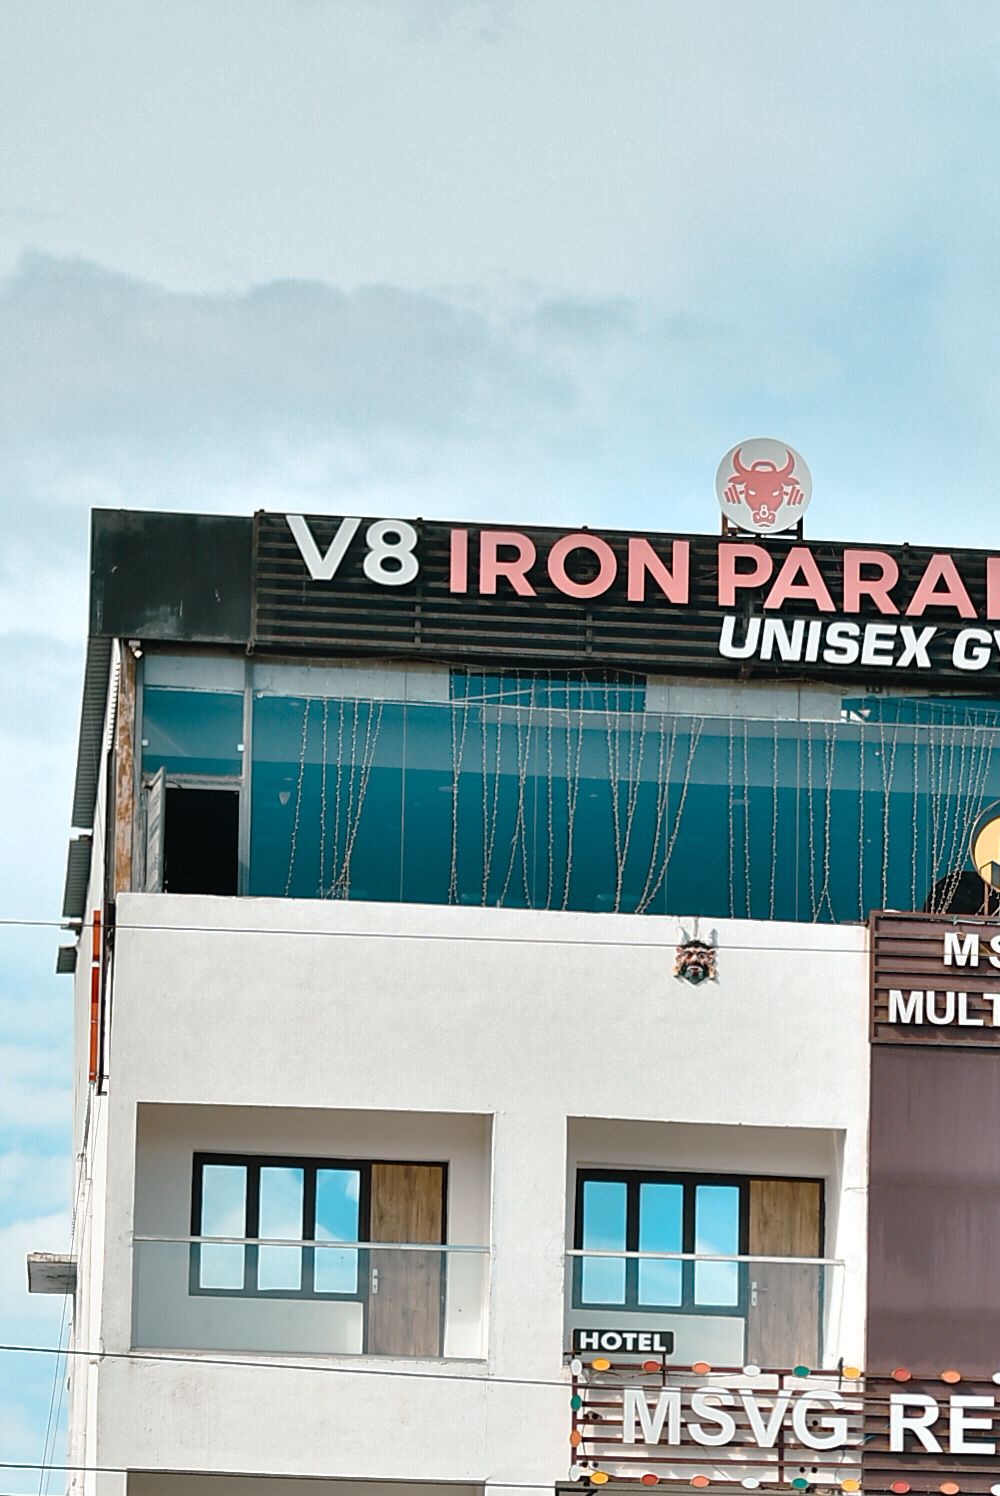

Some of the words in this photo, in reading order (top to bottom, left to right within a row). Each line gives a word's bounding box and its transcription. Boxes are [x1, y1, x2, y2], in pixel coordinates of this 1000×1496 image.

[286, 514, 420, 585] V8
[449, 528, 690, 604] IRON
[719, 615, 938, 669] UNISEX
[580, 1331, 667, 1352] HOTEL
[622, 1386, 849, 1451] MSVG
